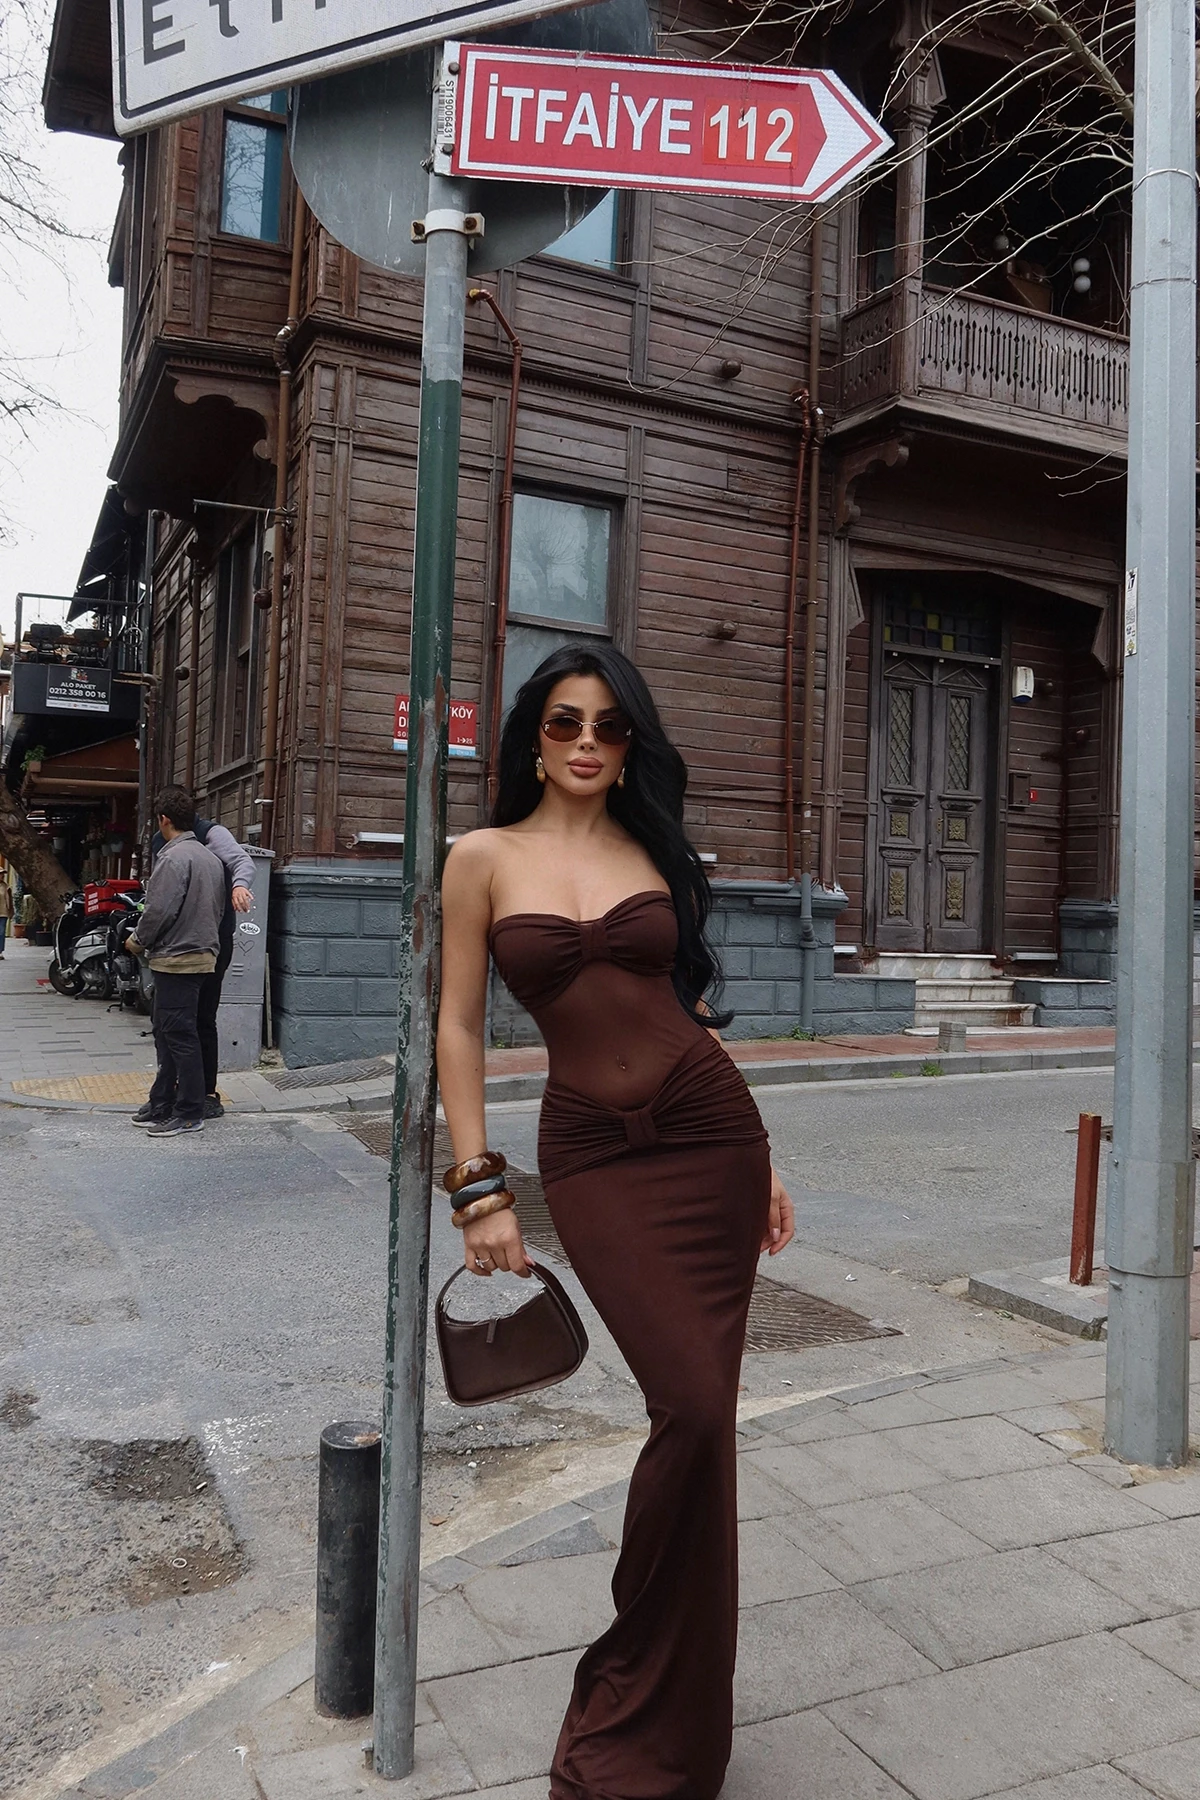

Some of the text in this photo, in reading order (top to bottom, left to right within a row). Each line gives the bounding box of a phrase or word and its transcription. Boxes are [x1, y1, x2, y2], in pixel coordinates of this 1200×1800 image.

[443, 80, 455, 140] ST19006431
[484, 72, 795, 163] İTFAİYE 112
[68, 689, 84, 697] 358
[85, 690, 96, 698] 00
[97, 691, 106, 699] 16
